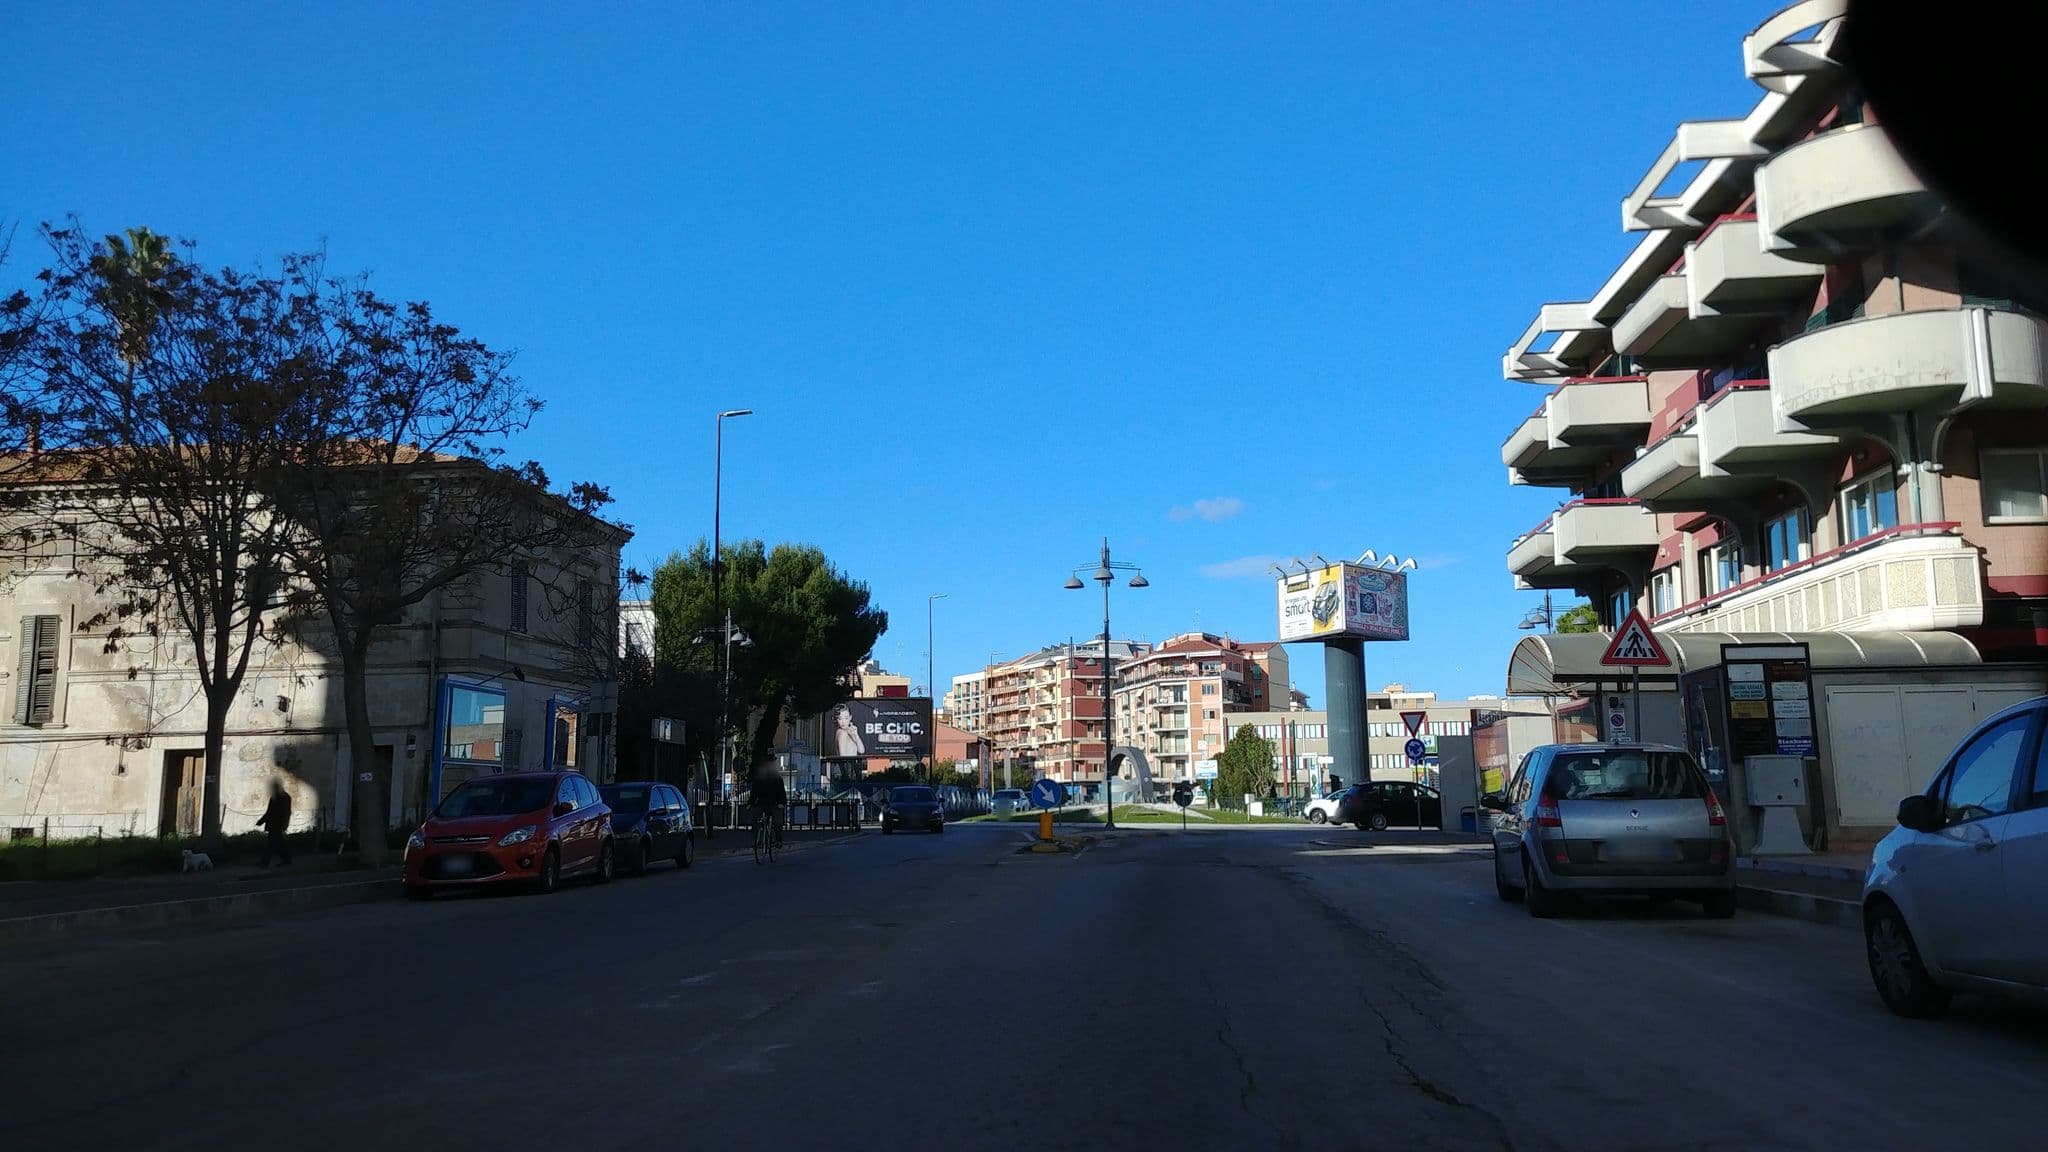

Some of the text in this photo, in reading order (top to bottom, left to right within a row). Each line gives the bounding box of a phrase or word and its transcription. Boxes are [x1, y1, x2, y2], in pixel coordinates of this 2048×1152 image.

[1285, 601, 1311, 618] smart
[865, 722, 924, 735] BE CHIC,
